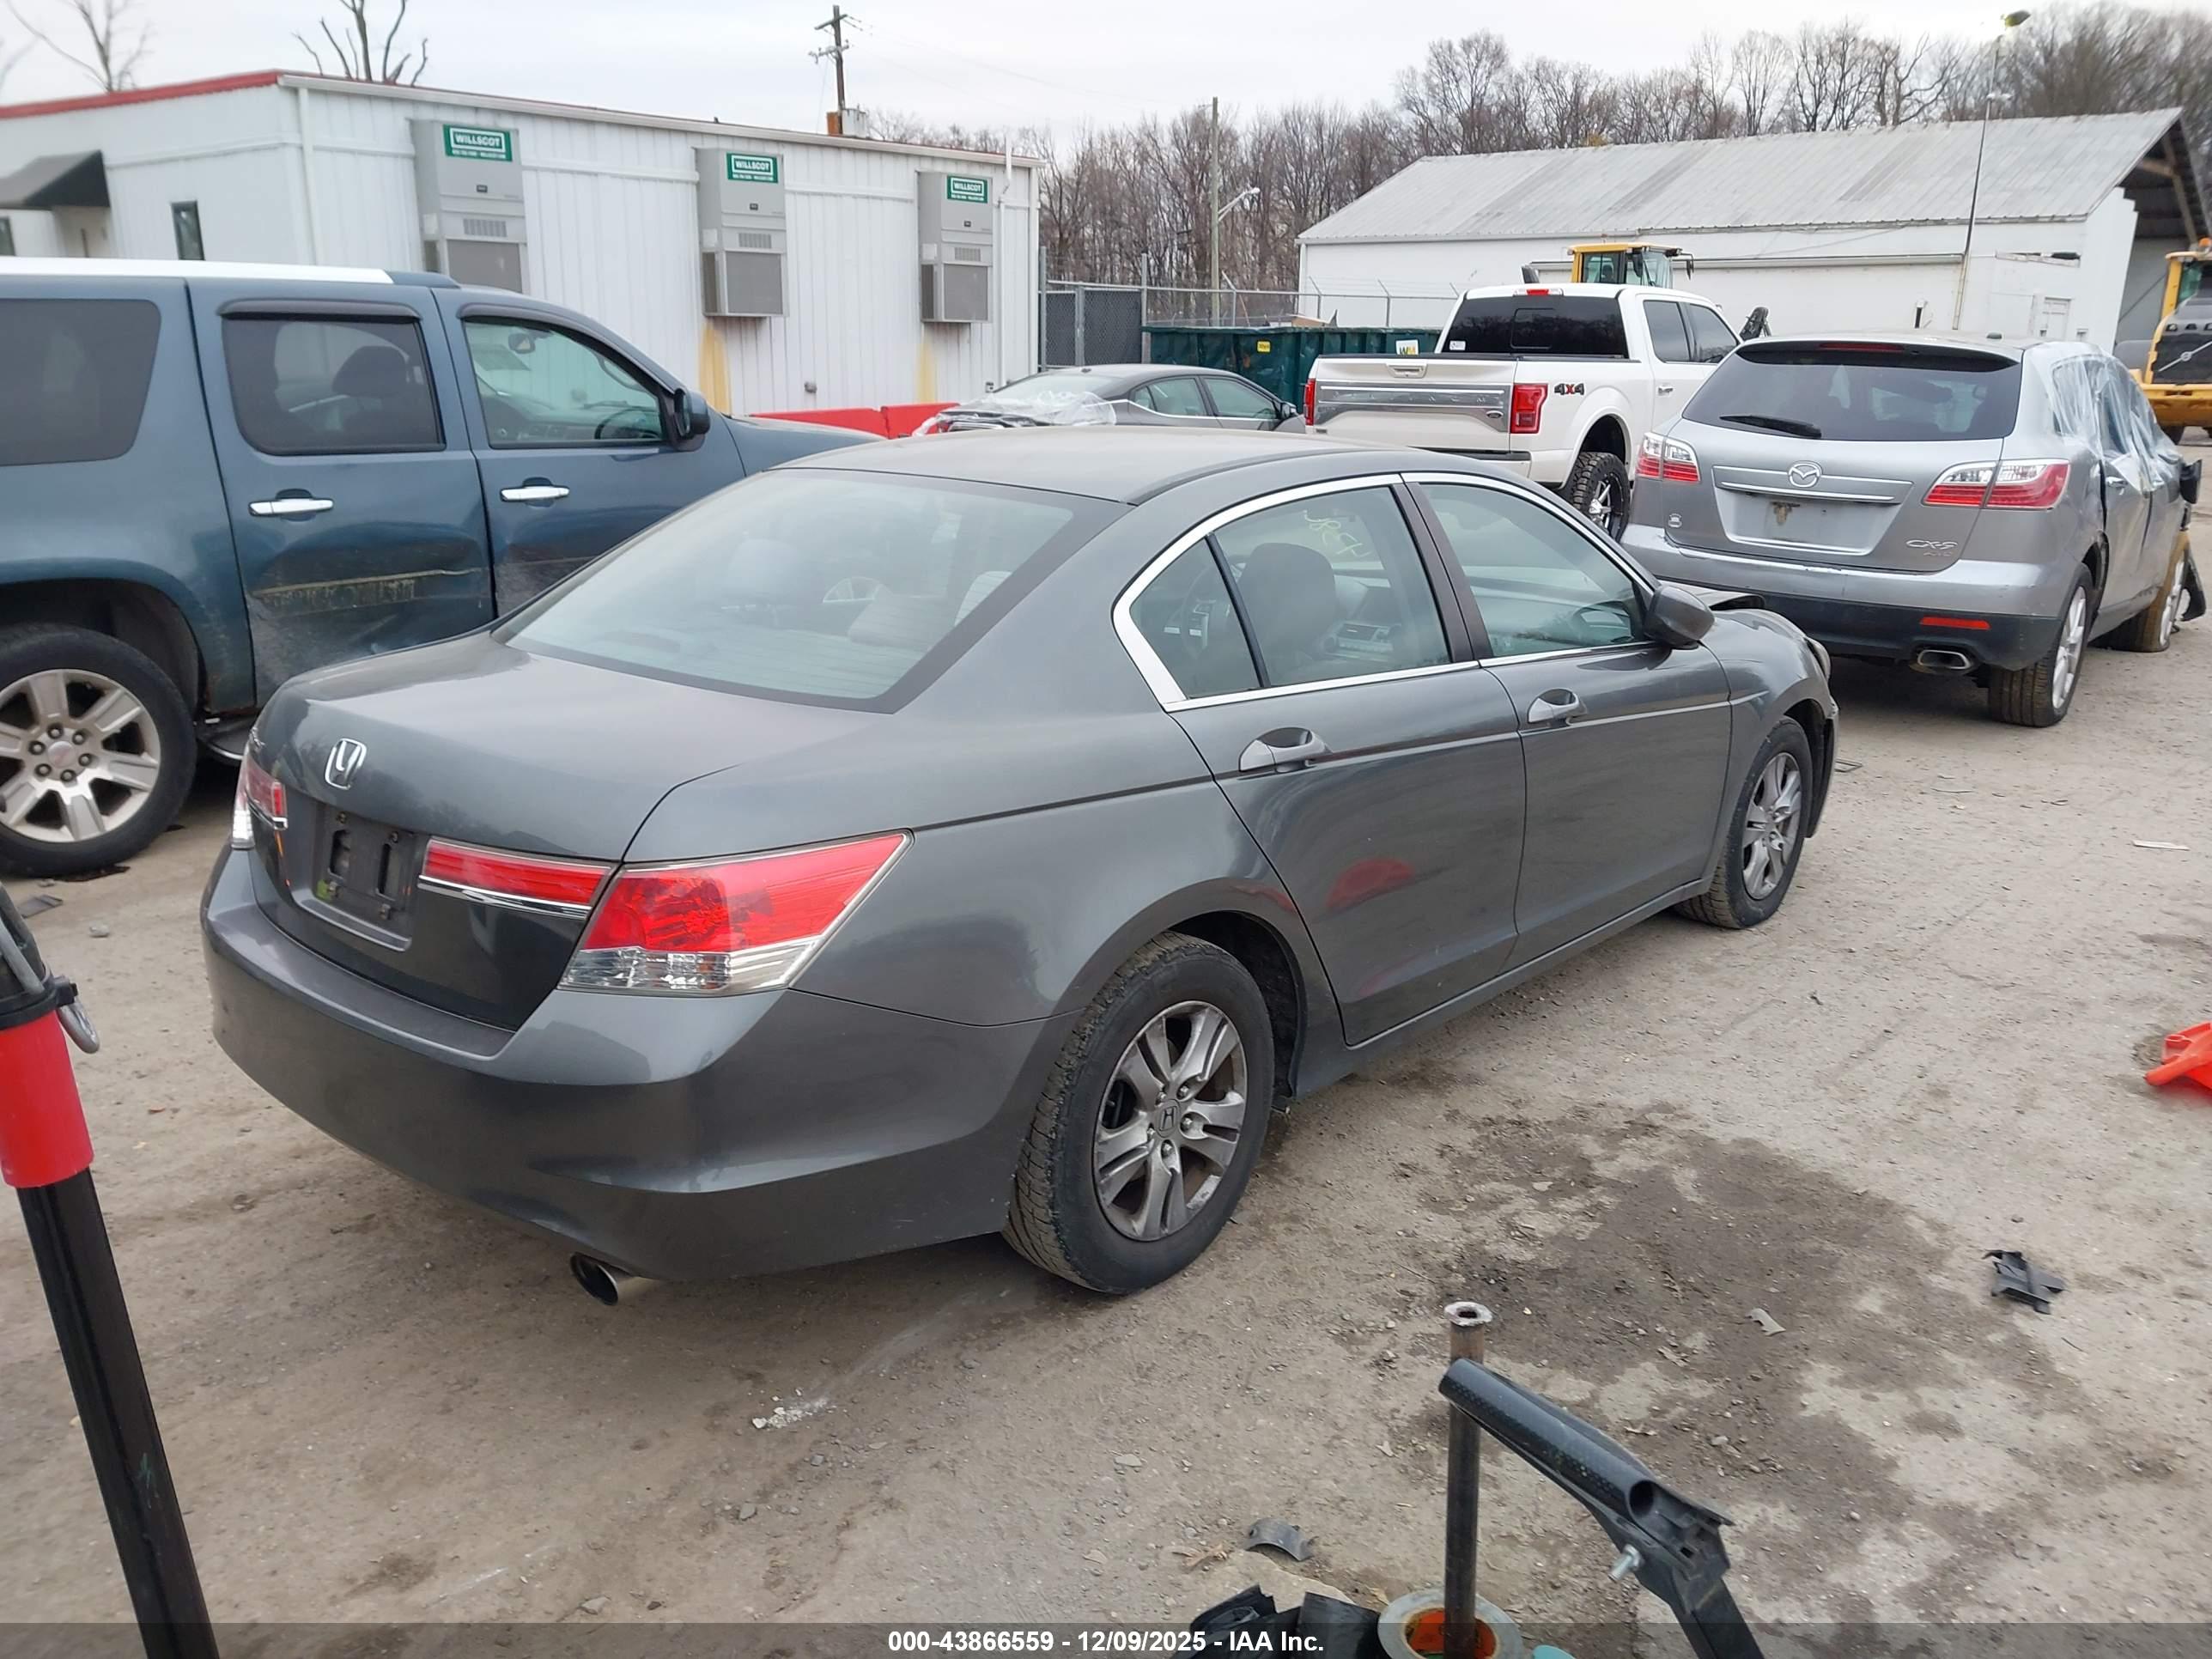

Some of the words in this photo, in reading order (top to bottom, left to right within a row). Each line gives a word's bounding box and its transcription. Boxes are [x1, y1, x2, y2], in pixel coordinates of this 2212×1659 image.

[454, 133, 501, 147] WILLSCOT
[735, 161, 769, 171] WILLSCOT
[1906, 539, 1958, 550] CX-9
